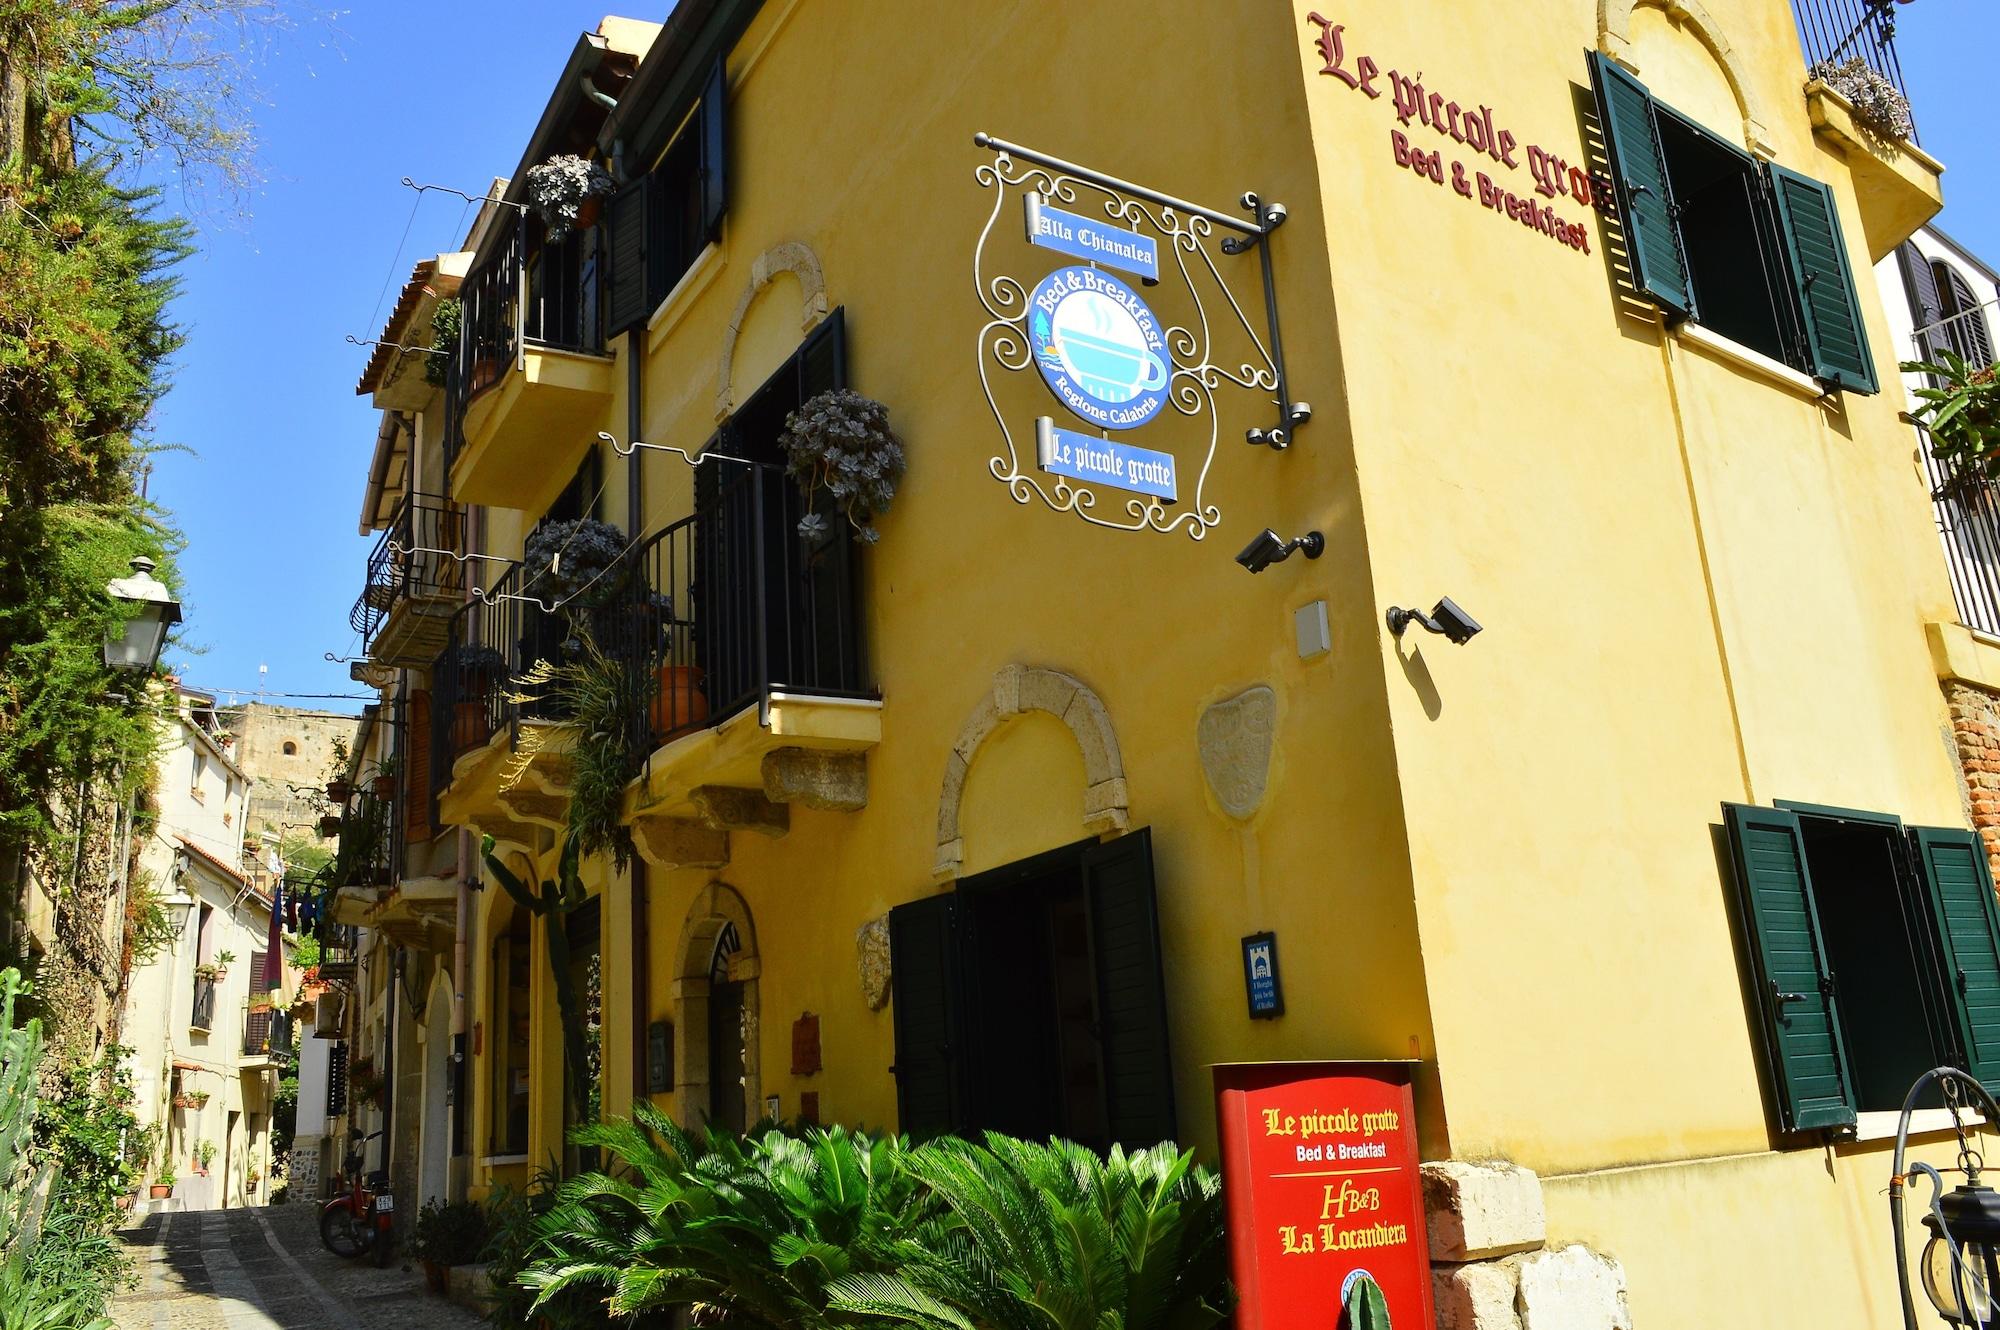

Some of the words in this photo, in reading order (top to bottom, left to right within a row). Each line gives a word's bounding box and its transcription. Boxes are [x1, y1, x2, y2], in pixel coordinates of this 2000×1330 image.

[1307, 11, 1382, 100] Le
[1388, 69, 1520, 171] piccole
[1391, 129, 1444, 185] Bed
[1451, 160, 1473, 198] &
[1476, 171, 1591, 256] Breakfast
[1040, 216, 1073, 241] Alla
[1077, 228, 1153, 265] Chianalea
[1055, 375, 1108, 421] Regione
[1109, 396, 1159, 424] Calabria
[1052, 434, 1071, 465] Le
[1075, 443, 1124, 477] piccole
[1128, 458, 1171, 487] grotte
[1262, 1108, 1297, 1137] Le
[1300, 1107, 1360, 1140] piccole
[1363, 1108, 1399, 1137] grotte
[1296, 1145, 1322, 1162] Bed
[1326, 1145, 1336, 1161] &
[1338, 1142, 1386, 1160] Breakfast
[1278, 1225, 1315, 1256] La
[1318, 1220, 1408, 1252] Locandiera
